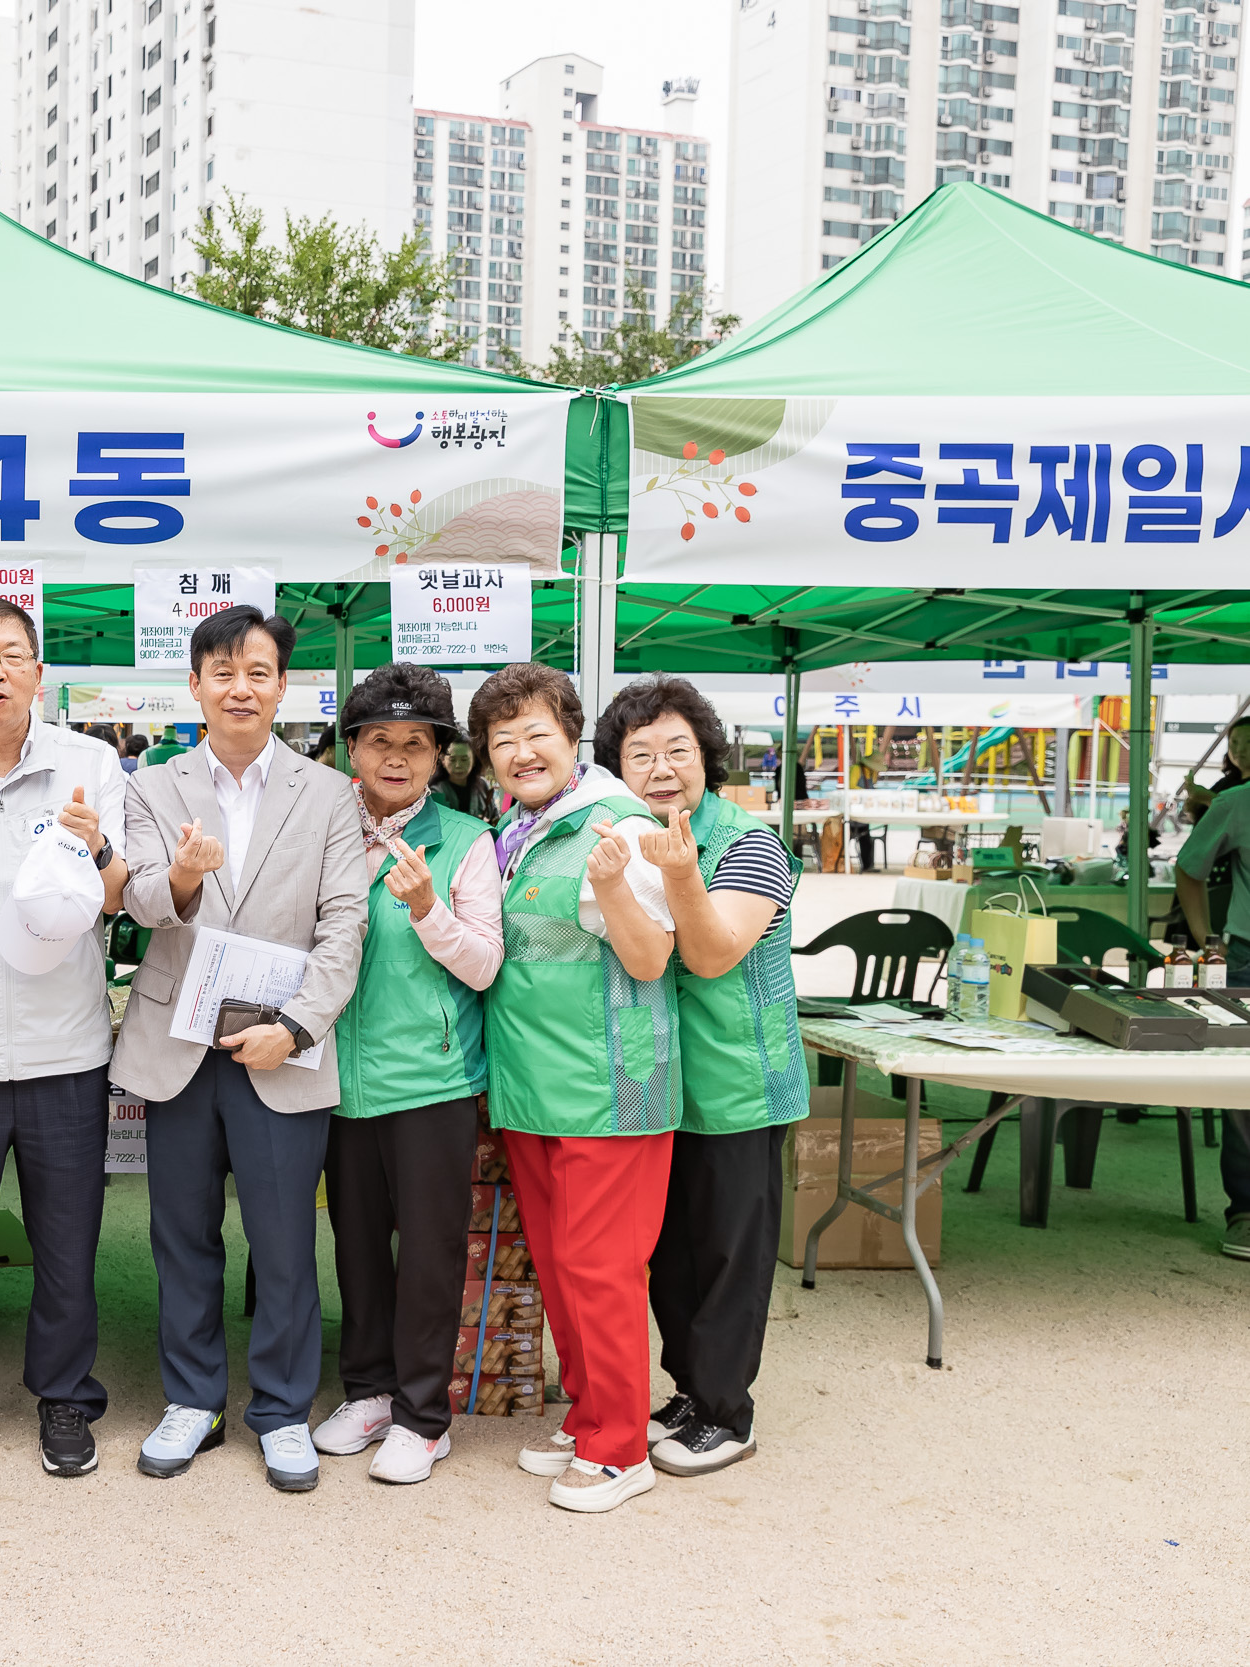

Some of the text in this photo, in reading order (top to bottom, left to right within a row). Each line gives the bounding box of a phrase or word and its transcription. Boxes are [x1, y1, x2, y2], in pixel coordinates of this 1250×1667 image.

[431, 409, 508, 425] 소통하며 발전하는
[431, 422, 507, 450] 행복광진
[418, 569, 504, 590] 옛날과자
[432, 596, 490, 613] 6,000원
[140, 626, 174, 637] 계좌이체
[397, 621, 478, 633] 계좌이체 가능합니다
[140, 638, 182, 648] 새마을금고
[397, 634, 440, 644] 새마을금고
[139, 649, 192, 660] 9002-2062-
[397, 644, 476, 656] 9002-2062-7222-0
